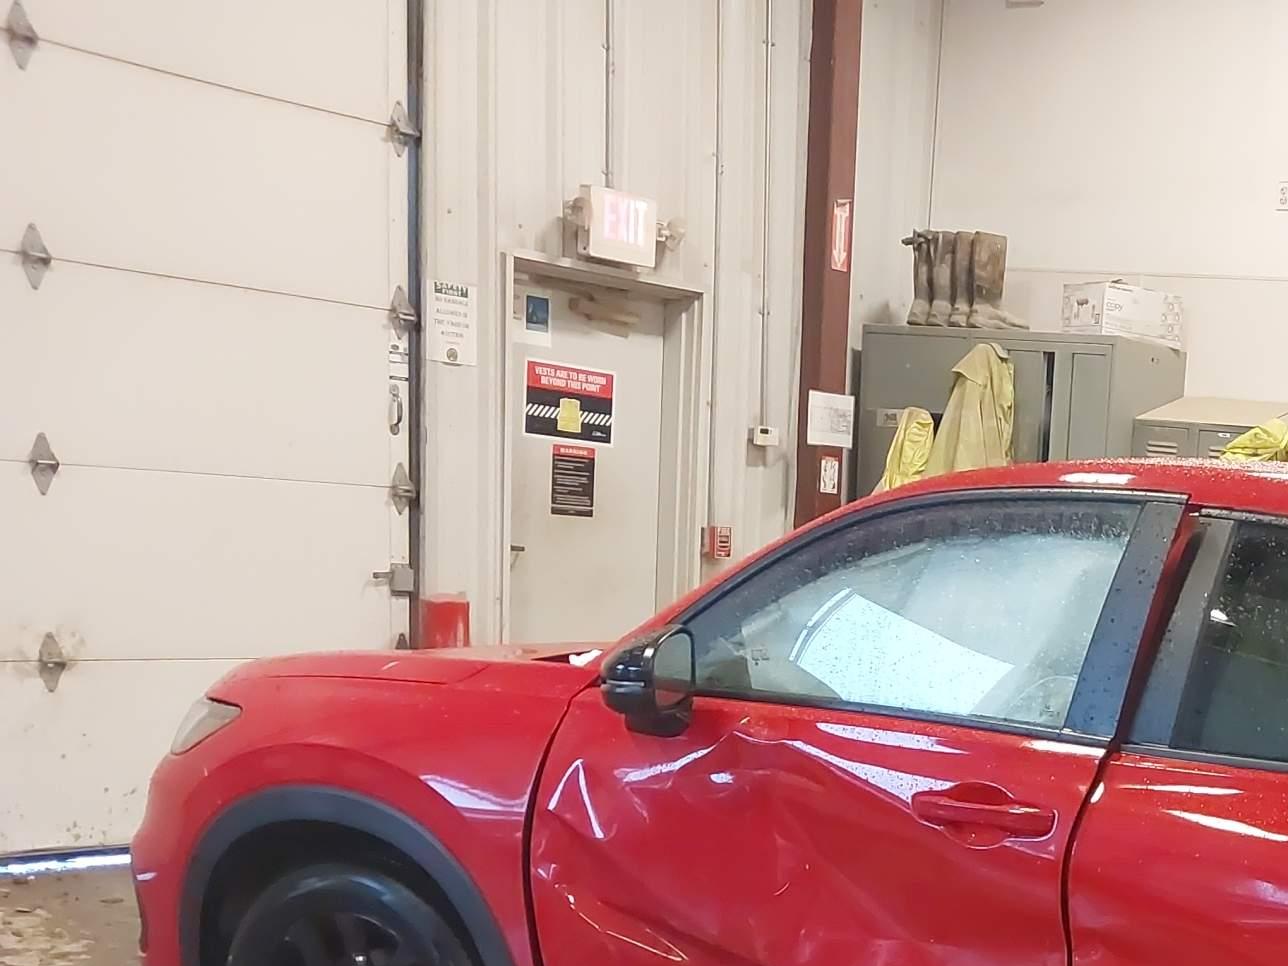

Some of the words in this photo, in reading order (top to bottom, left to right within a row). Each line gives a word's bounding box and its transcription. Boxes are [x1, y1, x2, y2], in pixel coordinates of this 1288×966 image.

[603, 194, 648, 246] EXIT
[534, 366, 555, 376] VESTS
[556, 369, 569, 378] ARE
[569, 371, 578, 381] TO
[579, 373, 587, 382] BE
[587, 374, 607, 385] WORN
[540, 376, 566, 387] BEYOND
[567, 380, 582, 389] THIS
[582, 382, 601, 392] POINT
